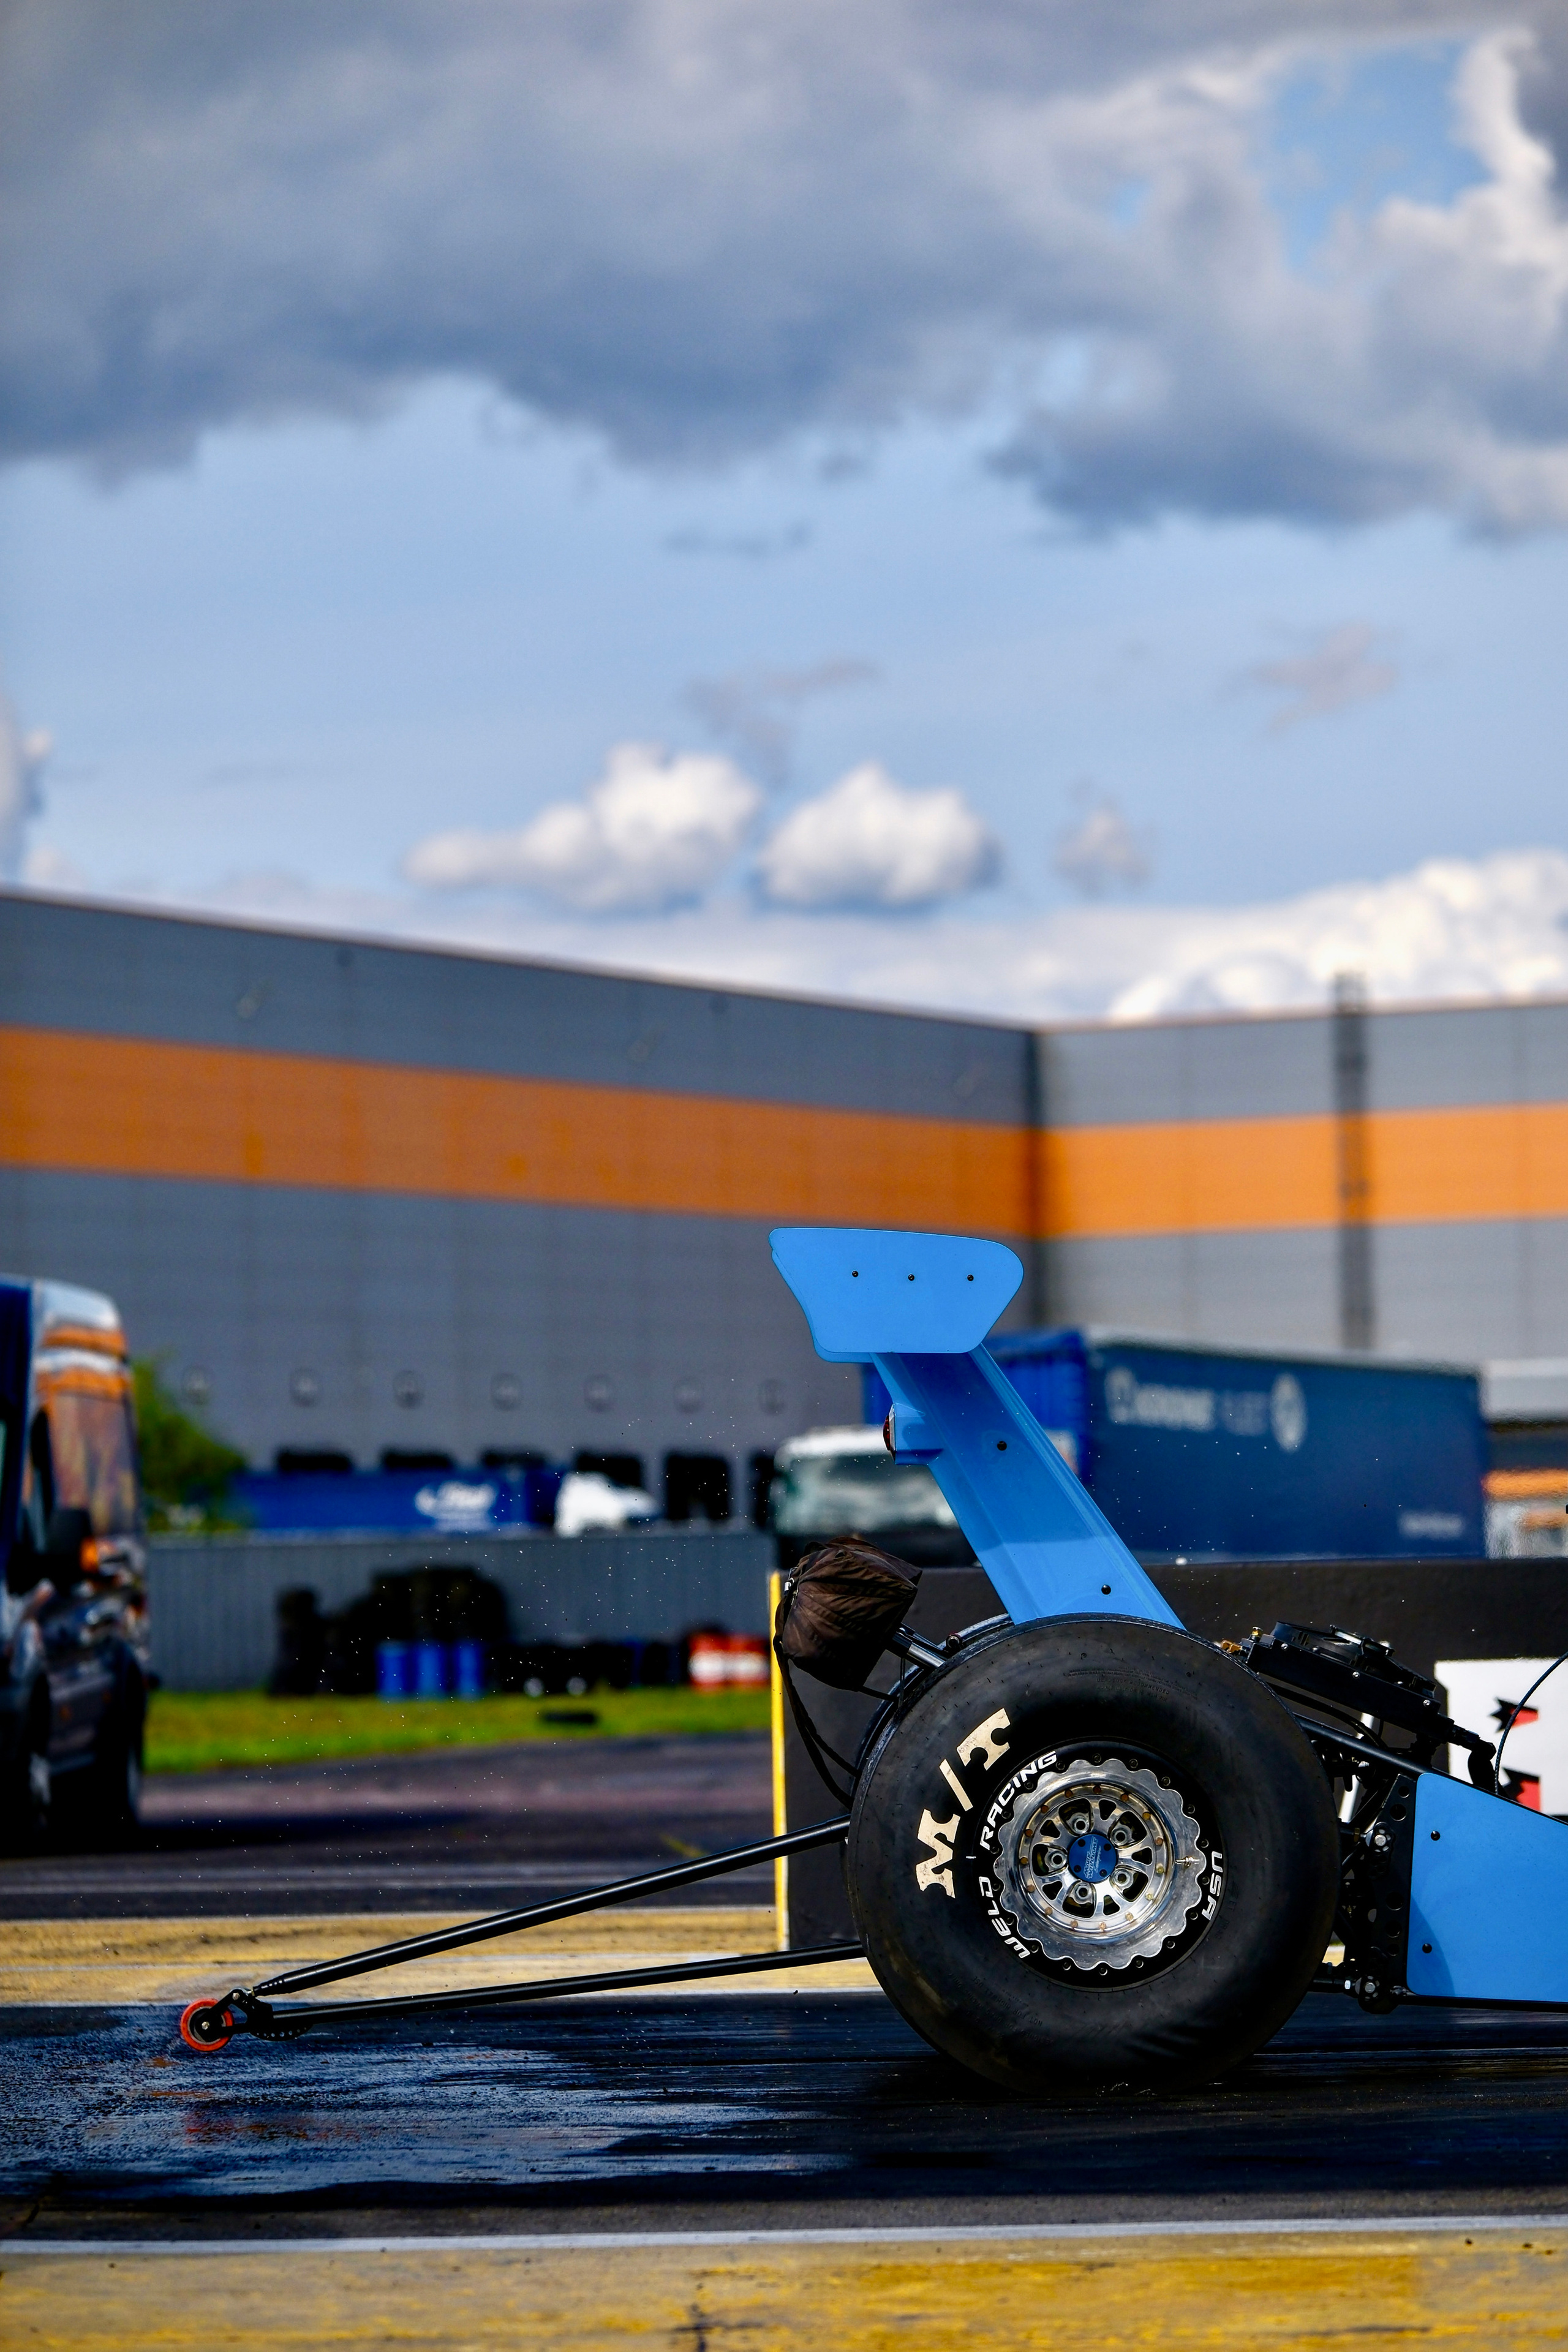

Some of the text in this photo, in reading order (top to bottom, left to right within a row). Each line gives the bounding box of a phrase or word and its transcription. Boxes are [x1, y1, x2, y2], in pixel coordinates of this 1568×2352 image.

[980, 1751, 1057, 1850] RACING
[979, 1876, 1030, 1959] WELD
[1201, 1851, 1223, 1921] USA
